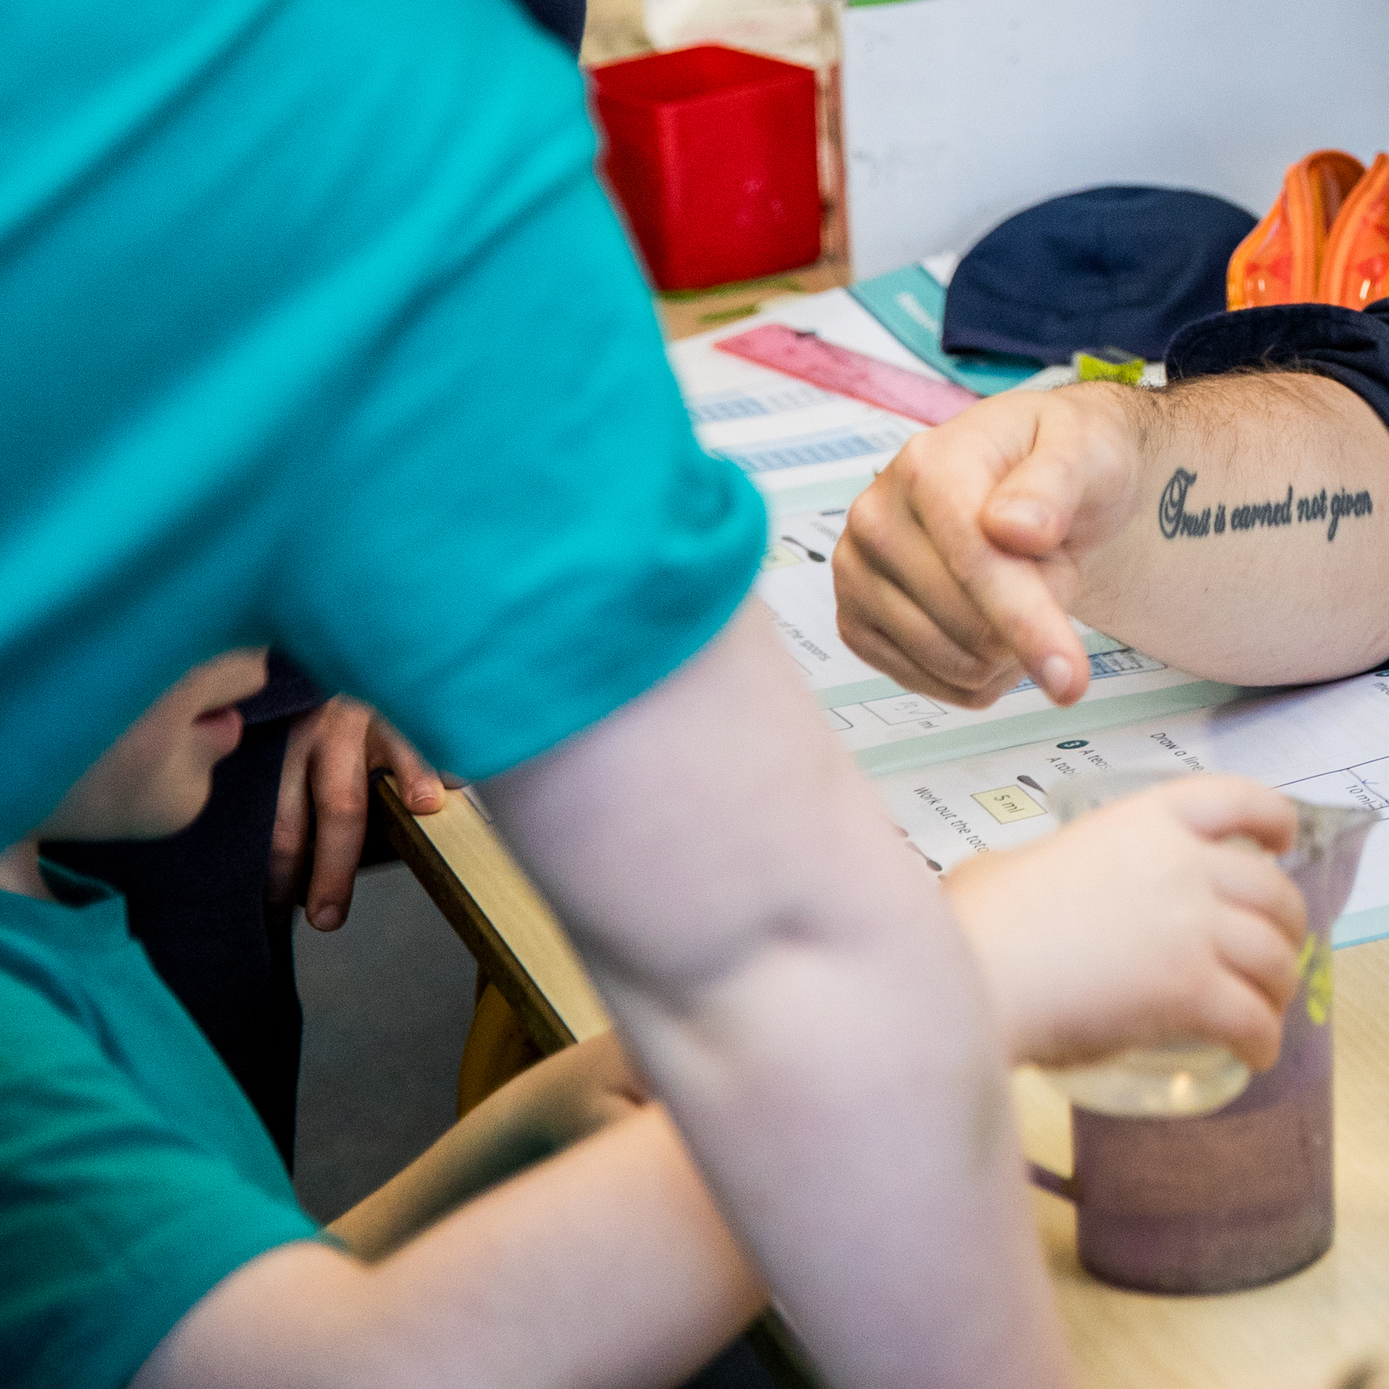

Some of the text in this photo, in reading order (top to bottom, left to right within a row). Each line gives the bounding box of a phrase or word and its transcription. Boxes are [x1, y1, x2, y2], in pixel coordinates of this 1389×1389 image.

[1213, 501, 1227, 534] is
[1231, 483, 1294, 532] earned
[1297, 487, 1328, 523] not
[1326, 485, 1374, 542] given
[1046, 756, 1062, 764] A
[1150, 732, 1180, 750] Draw
[1182, 756, 1205, 771] line
[913, 786, 942, 806] Work
[935, 805, 957, 820] out
[951, 819, 971, 835] the
[994, 793, 1025, 814] 5 ml
